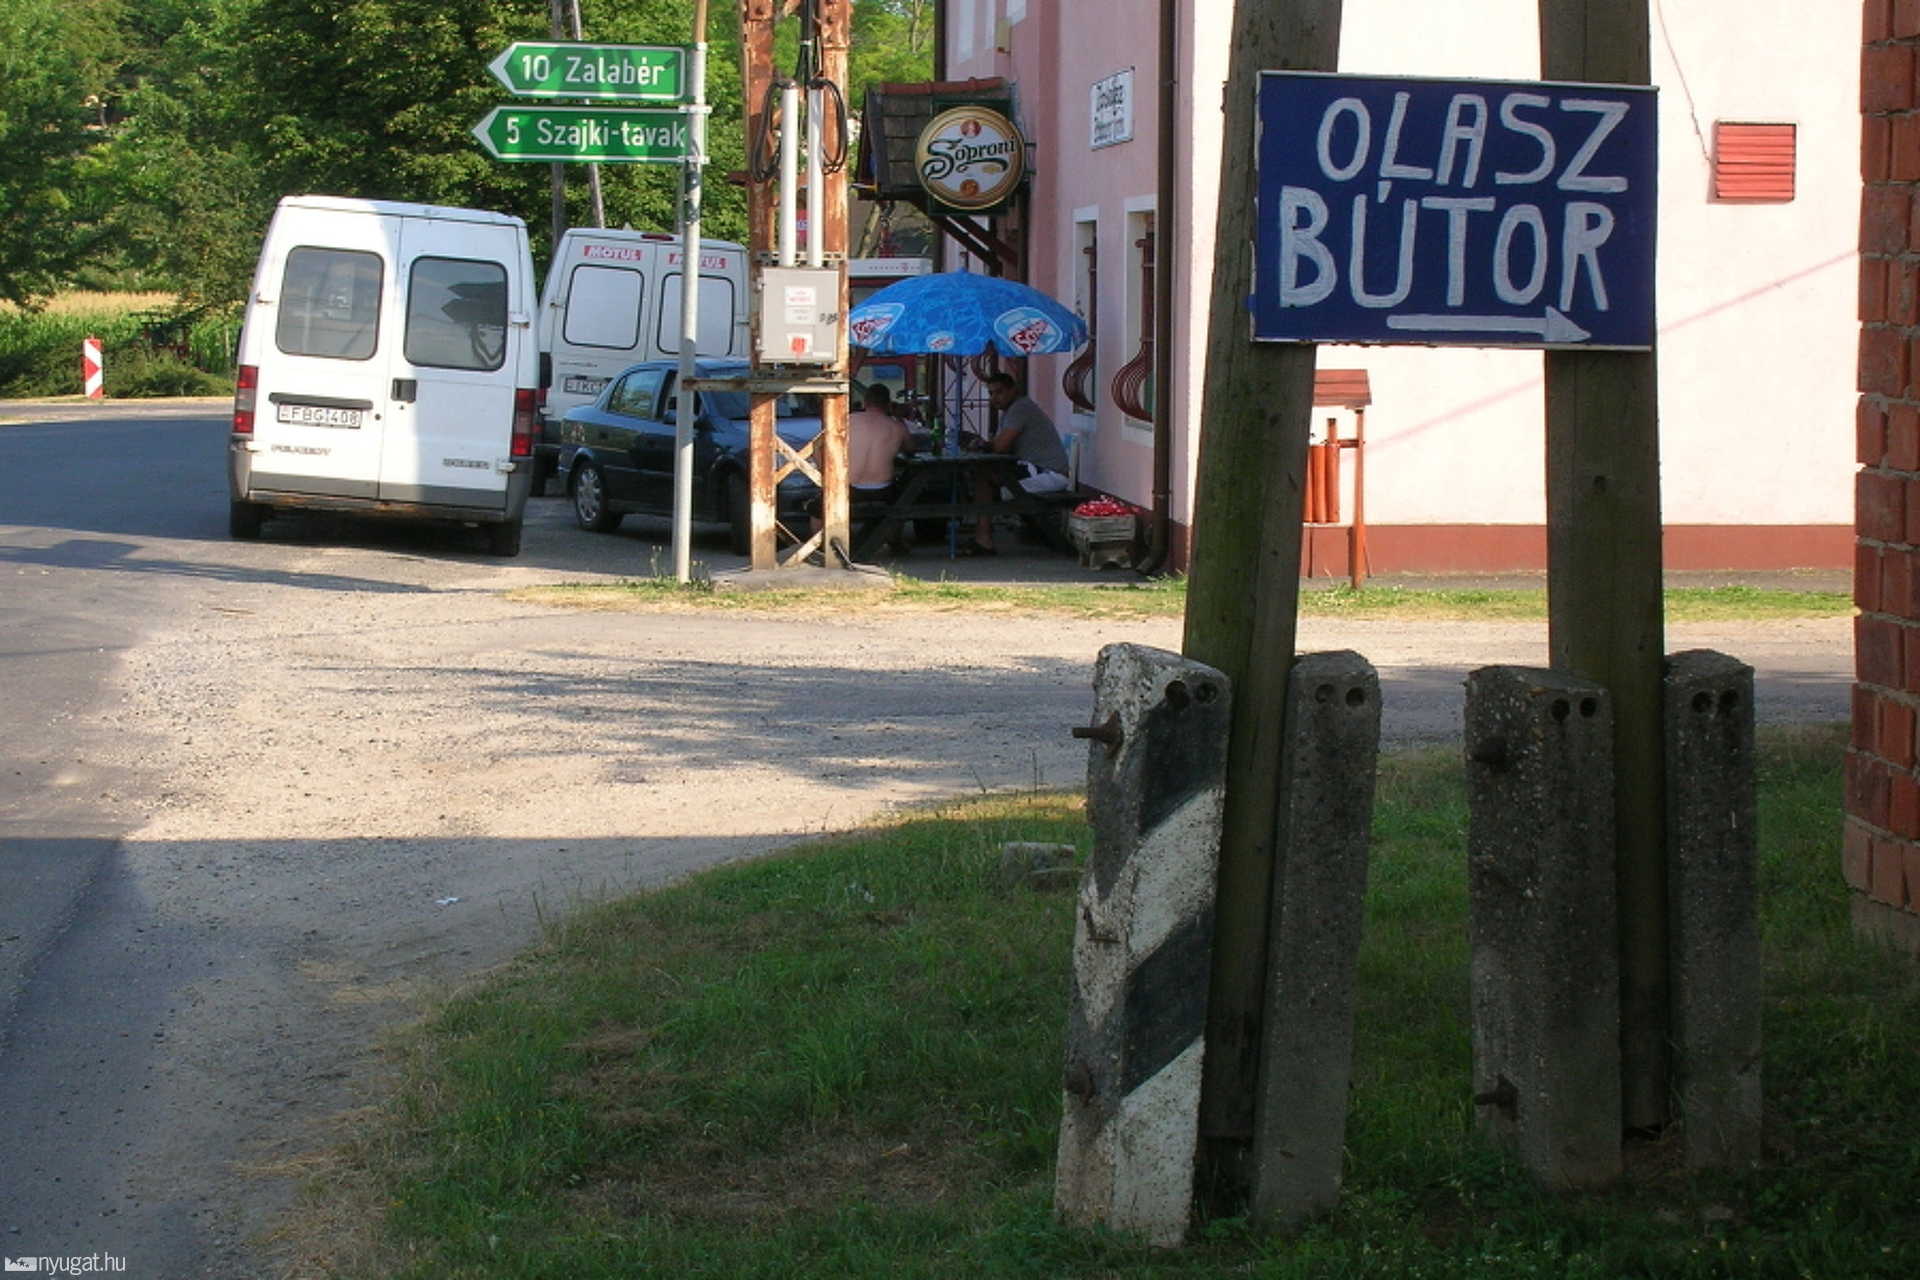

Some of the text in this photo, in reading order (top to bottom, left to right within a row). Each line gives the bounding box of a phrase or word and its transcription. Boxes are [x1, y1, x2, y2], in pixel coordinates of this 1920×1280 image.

[522, 55, 665, 85] 10 Zalabér
[507, 117, 686, 152] 5 Szajki-tavak
[1316, 91, 1630, 192] OLASZ
[922, 136, 1017, 179] Soproni
[1279, 181, 1615, 312] BÚTOR
